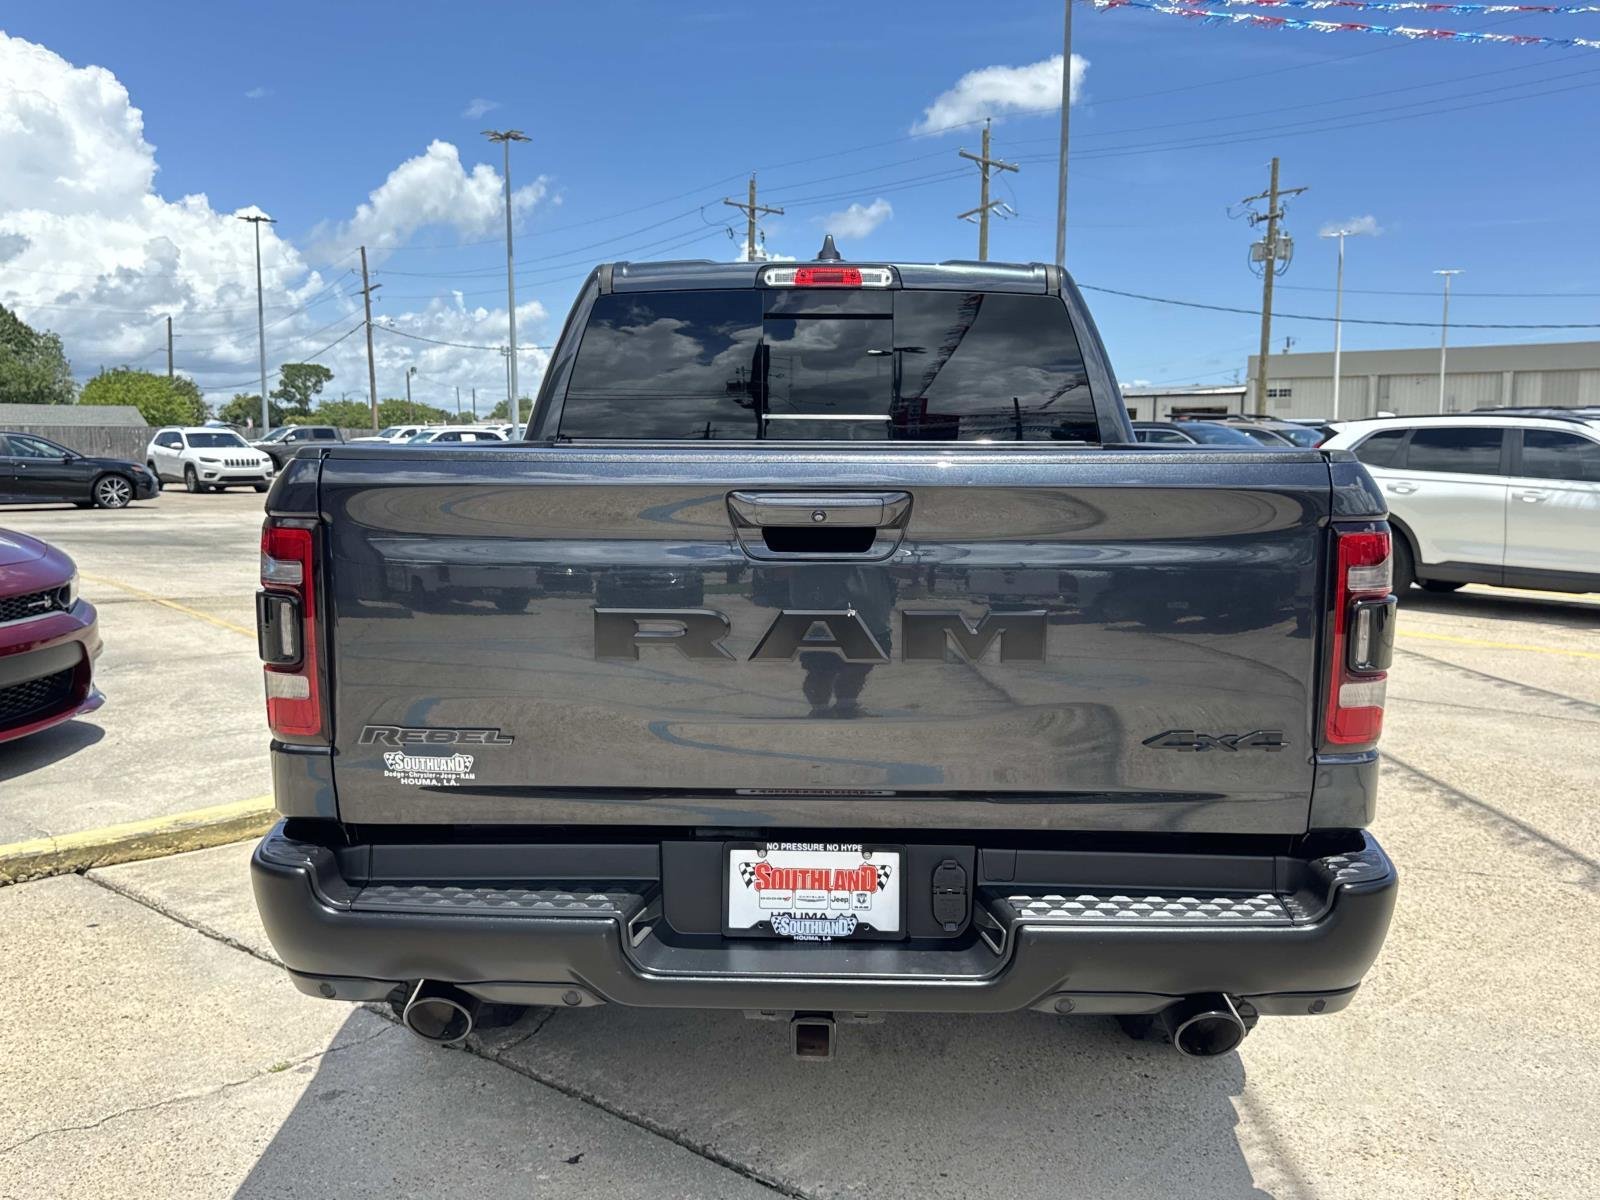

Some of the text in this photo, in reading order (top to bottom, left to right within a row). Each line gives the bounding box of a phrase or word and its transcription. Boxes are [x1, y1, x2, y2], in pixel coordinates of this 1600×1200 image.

[593, 607, 1048, 663] RAM
[358, 725, 514, 747] REBEL
[394, 754, 465, 772] SOUTHLAND
[384, 770, 404, 778] Dodge
[409, 771, 435, 779] Chrysler
[766, 842, 863, 852] NO PRESSURE NO HYPE
[754, 863, 878, 893] SOUTHLAND
[831, 895, 849, 904] Jeep
[781, 917, 848, 935] SOUTHLAND
